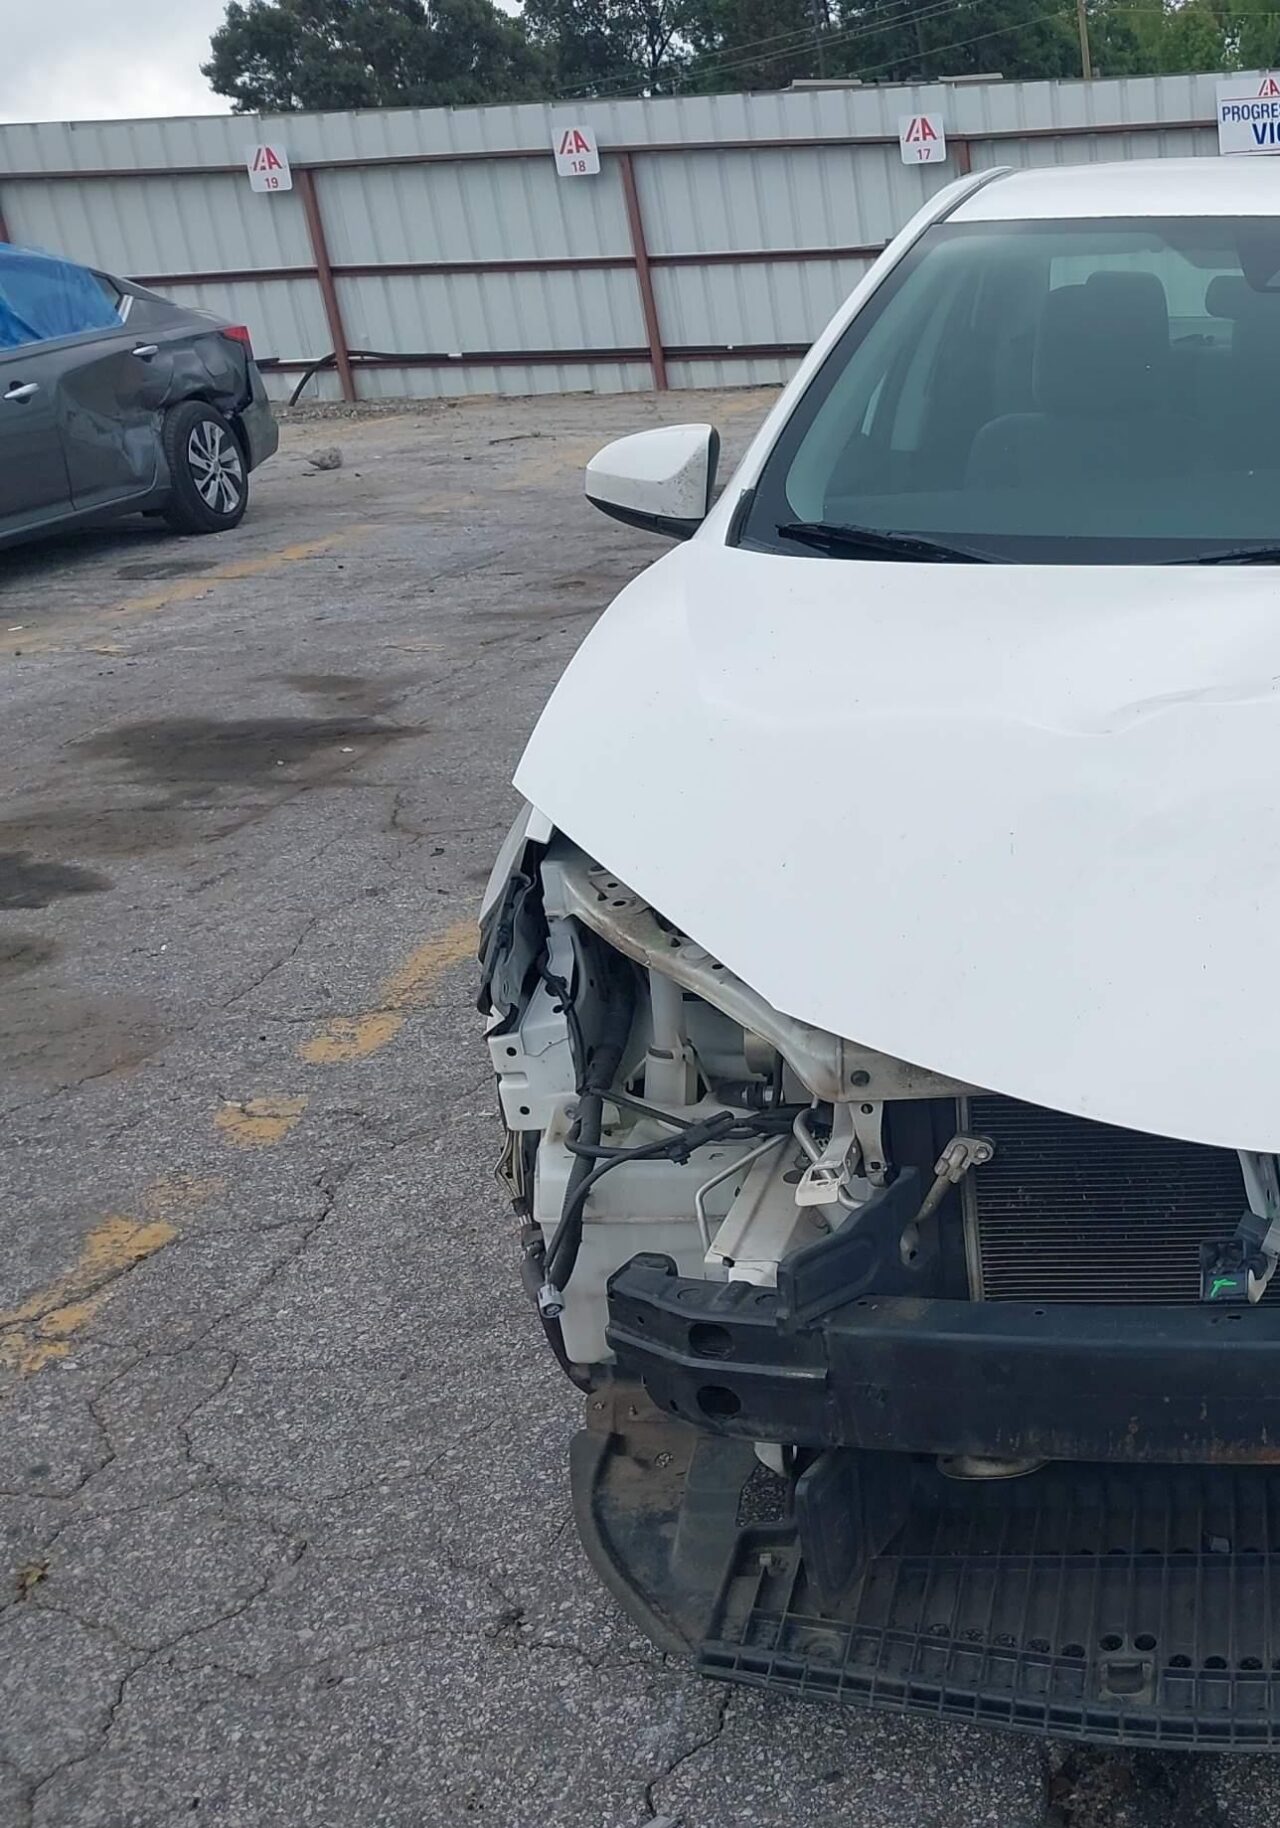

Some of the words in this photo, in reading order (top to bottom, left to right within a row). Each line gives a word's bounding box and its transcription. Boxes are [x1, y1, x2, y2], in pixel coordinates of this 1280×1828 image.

[917, 148, 931, 160] 17
[571, 160, 586, 172] 18
[264, 177, 279, 189] 19
